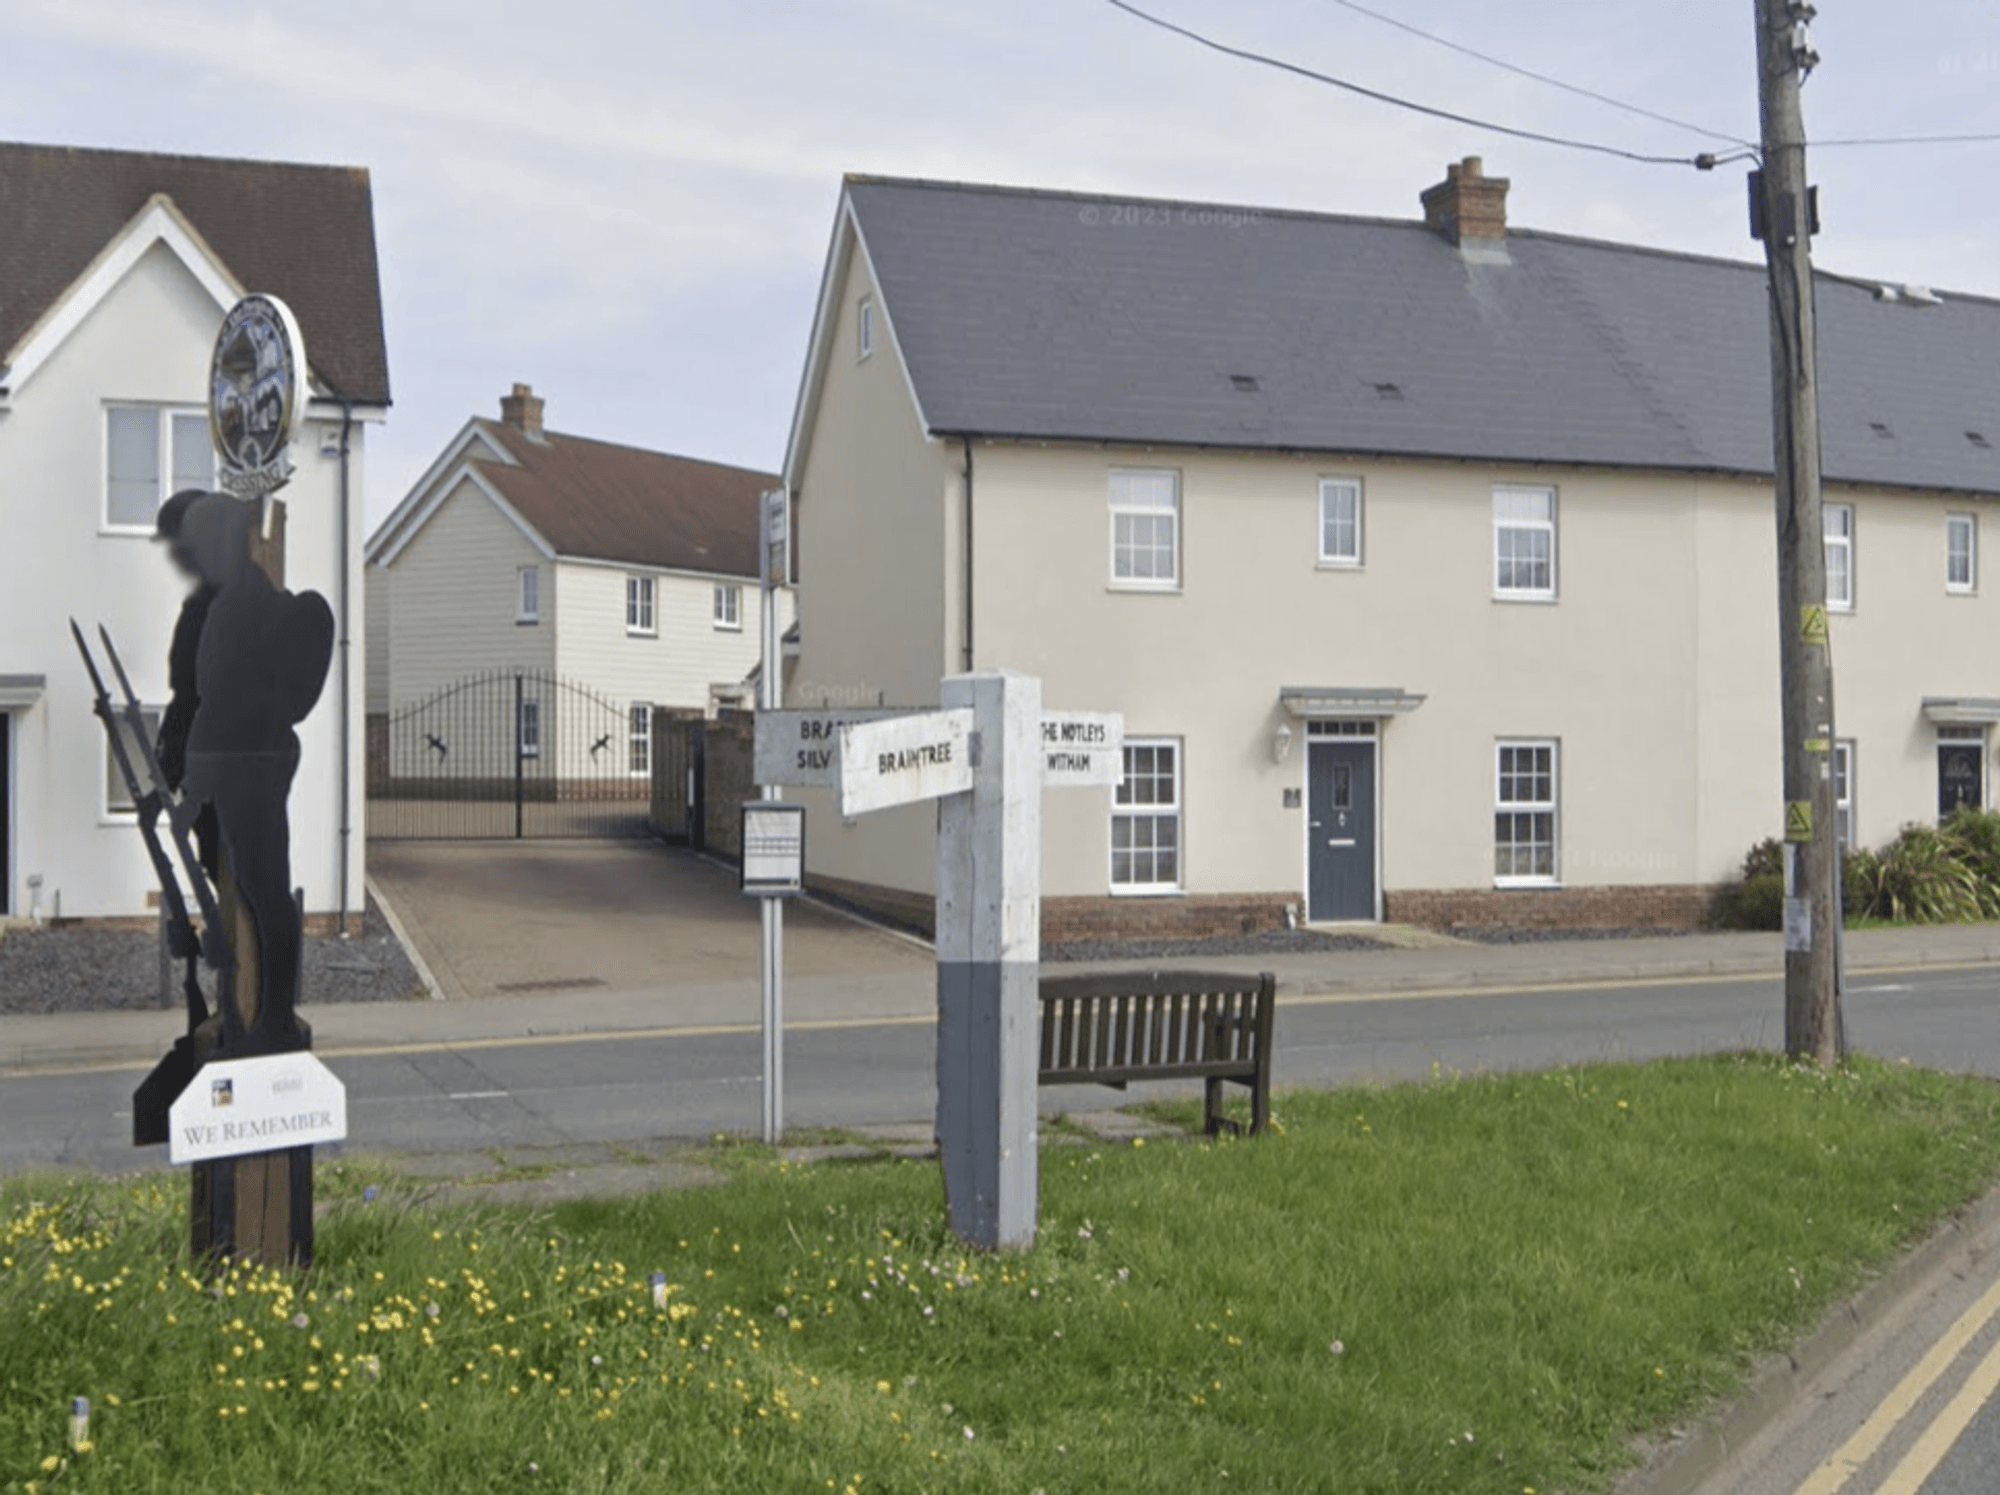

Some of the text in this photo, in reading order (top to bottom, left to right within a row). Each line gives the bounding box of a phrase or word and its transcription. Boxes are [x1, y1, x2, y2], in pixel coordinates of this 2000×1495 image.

[1061, 722, 1105, 742] NOTLEYS
[797, 750, 832, 770] SILV
[878, 742, 952, 775] BRAINTREE
[1047, 753, 1090, 771] WITHAM
[184, 1110, 332, 1146] WE REMEMBER
